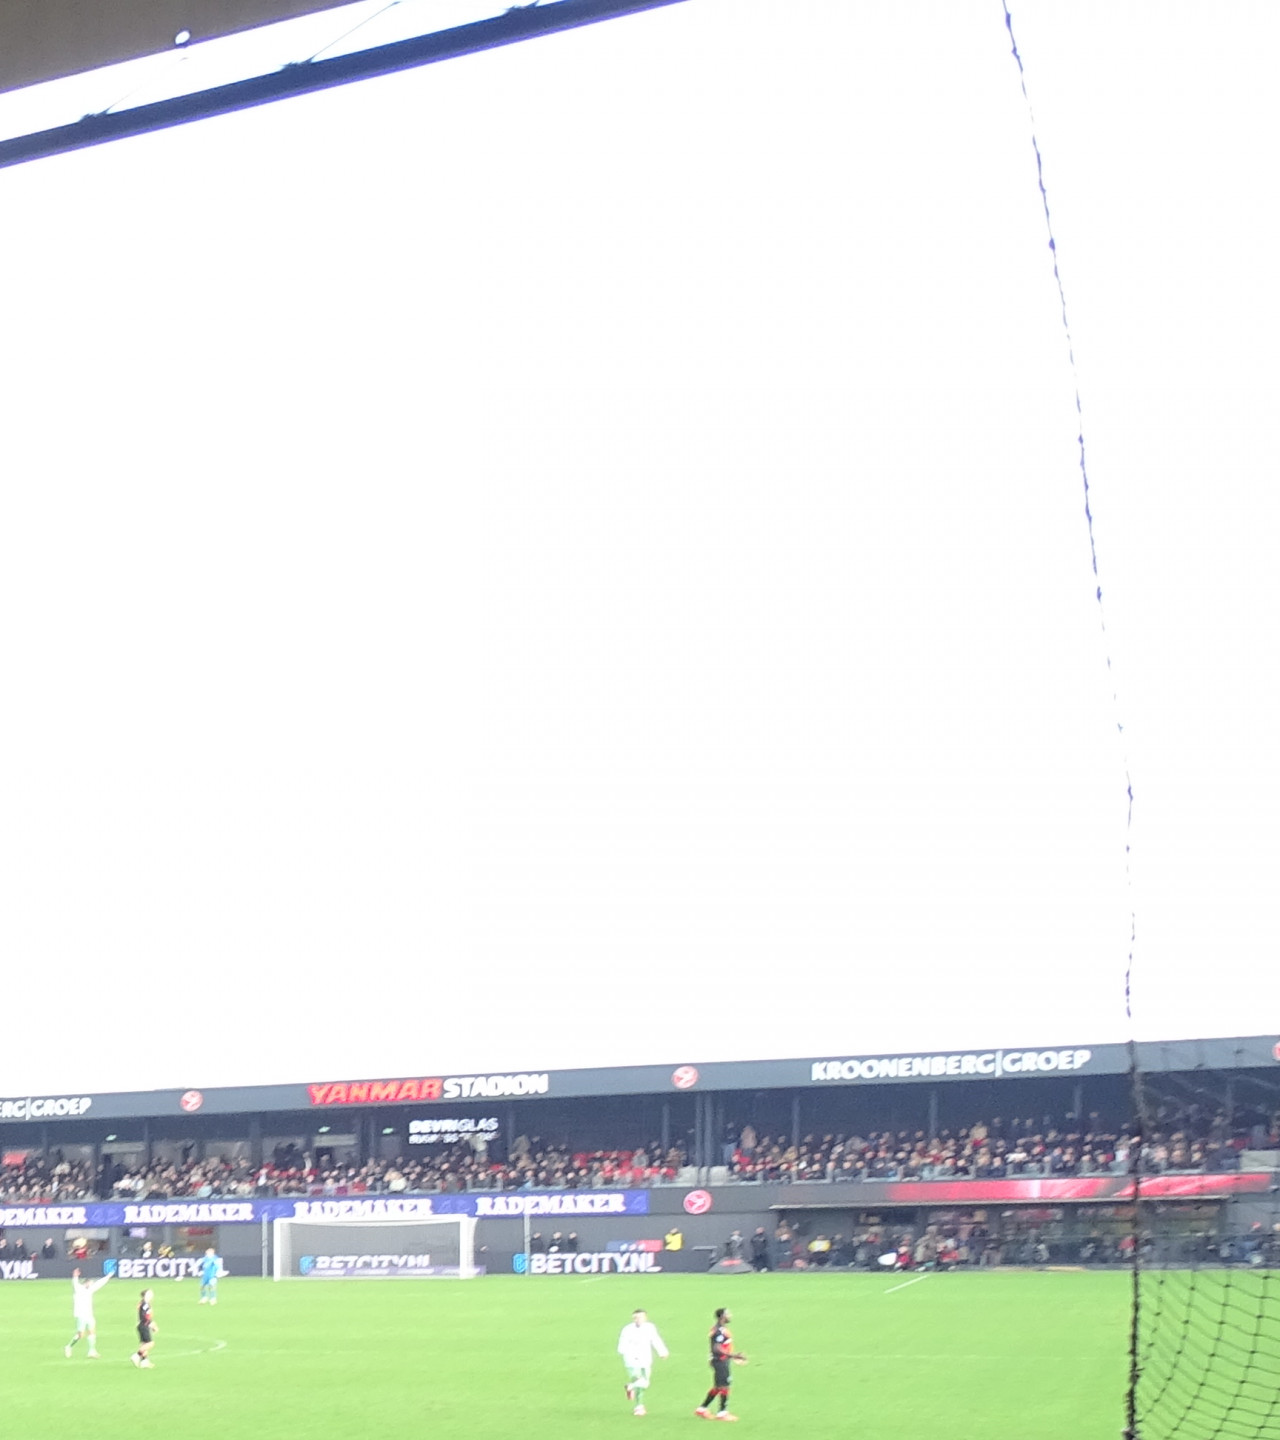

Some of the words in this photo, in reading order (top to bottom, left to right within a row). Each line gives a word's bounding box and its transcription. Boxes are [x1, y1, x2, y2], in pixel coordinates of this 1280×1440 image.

[307, 1077, 443, 1106] YANMAR
[443, 1073, 550, 1099] STADION
[123, 1203, 255, 1224] RADEMAKER
[475, 1193, 627, 1217] RADEMAKER
[118, 1257, 231, 1279] BETCITYL
[315, 1253, 432, 1268] BETCITYNL
[529, 1251, 663, 1275] BETCITY.NL
